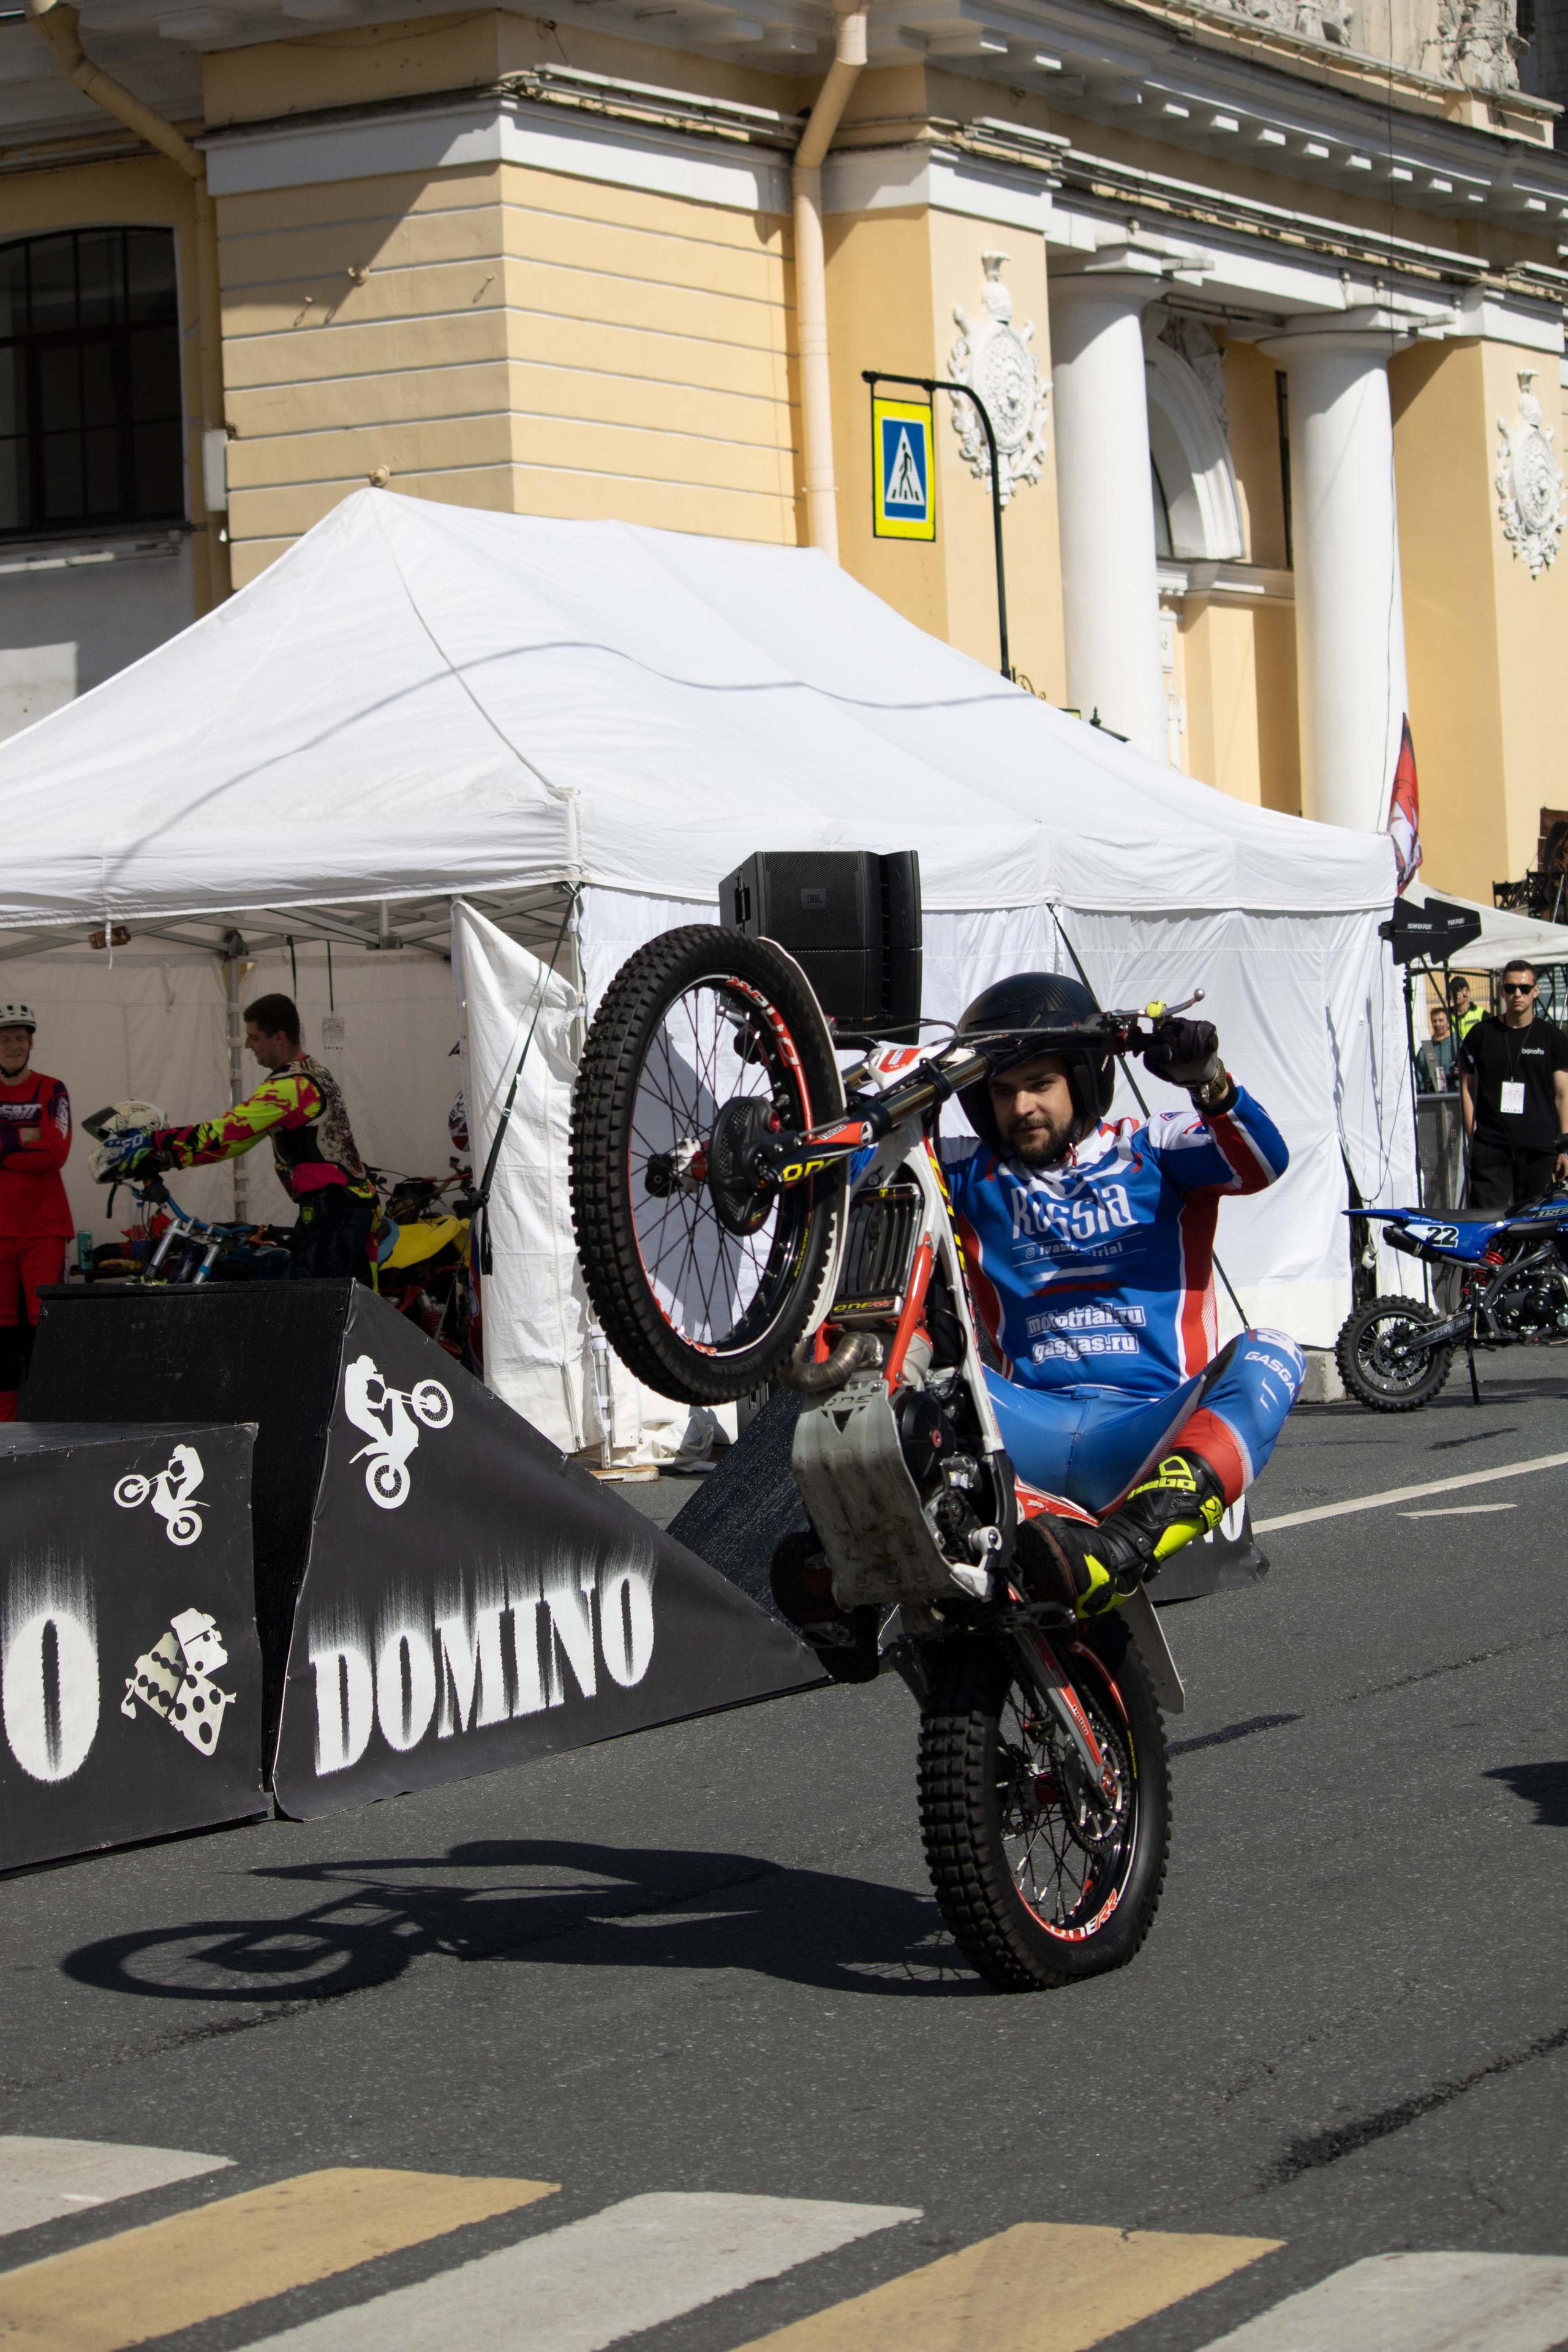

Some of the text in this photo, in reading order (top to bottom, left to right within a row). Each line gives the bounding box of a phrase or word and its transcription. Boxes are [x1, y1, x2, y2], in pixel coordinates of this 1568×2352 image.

[807, 895, 823, 903] JBL
[0, 1104, 42, 1120] EATT
[1427, 1226, 1458, 1246] 22
[1027, 1305, 1144, 1336] mototrial.ru
[1033, 1335, 1137, 1363] gasgas.ru
[309, 1572, 654, 1777] DOMINO
